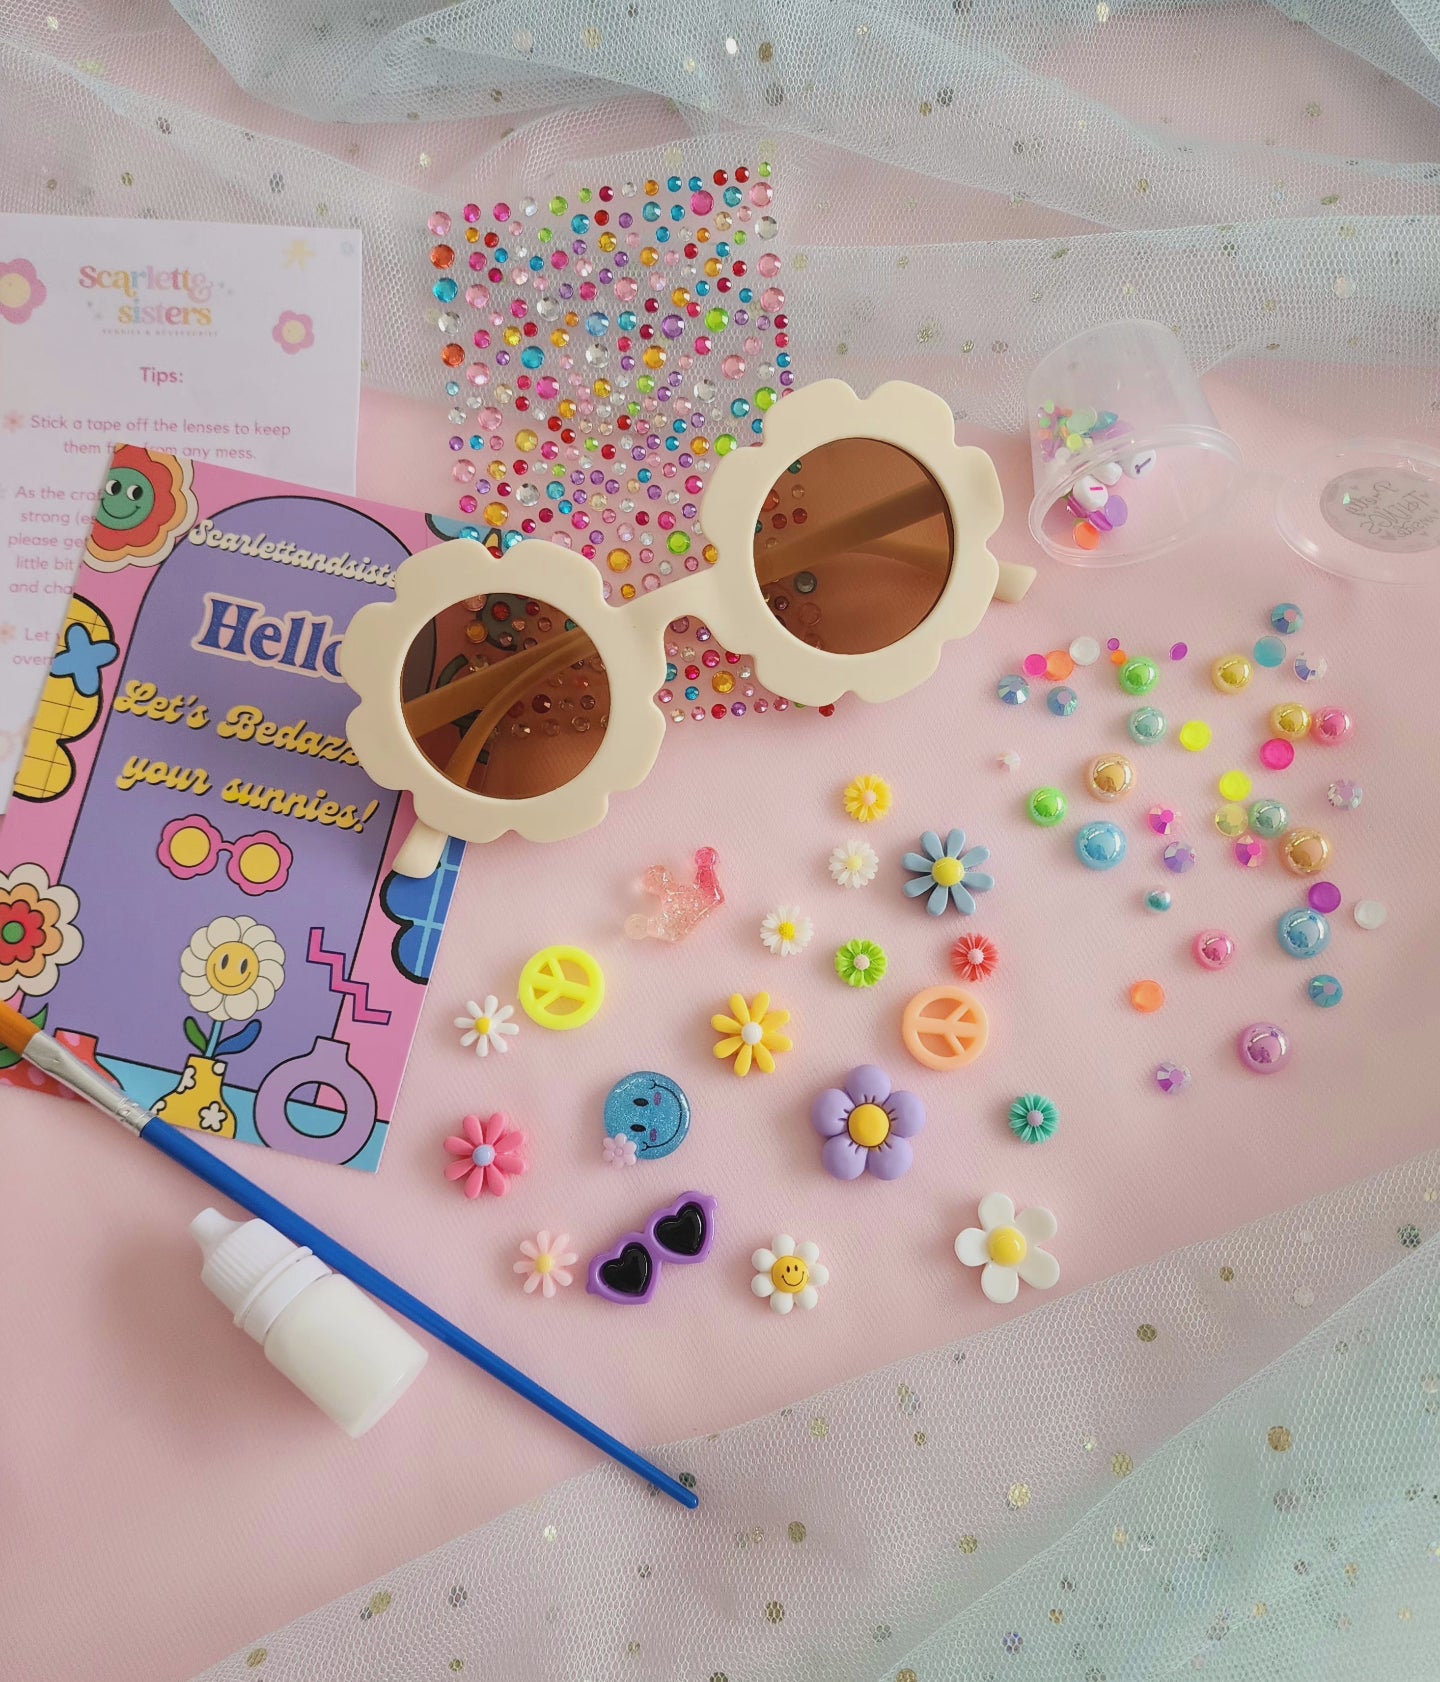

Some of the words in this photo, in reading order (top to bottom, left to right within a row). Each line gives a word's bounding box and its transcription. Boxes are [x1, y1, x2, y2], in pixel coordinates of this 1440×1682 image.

[118, 298, 212, 325] sisters
[139, 366, 184, 387] Tips:
[31, 415, 68, 430] Stick
[73, 420, 83, 430] a
[87, 418, 121, 434] tape
[126, 418, 148, 431] off
[153, 418, 178, 432] the
[183, 421, 230, 435] lenses
[235, 423, 249, 435] to
[254, 421, 291, 439] keep
[64, 441, 101, 454] them
[183, 446, 209, 461] any
[215, 448, 256, 460] mess.
[15, 486, 35, 499] As
[41, 487, 65, 500] the
[21, 511, 70, 526] strong
[8, 532, 57, 548] please
[16, 555, 48, 570] little
[54, 557, 74, 571] bit
[9, 580, 39, 593] and
[24, 627, 48, 642] Let
[113, 680, 210, 729] Let's
[116, 755, 213, 795] your
[221, 777, 380, 832] sunnies!
